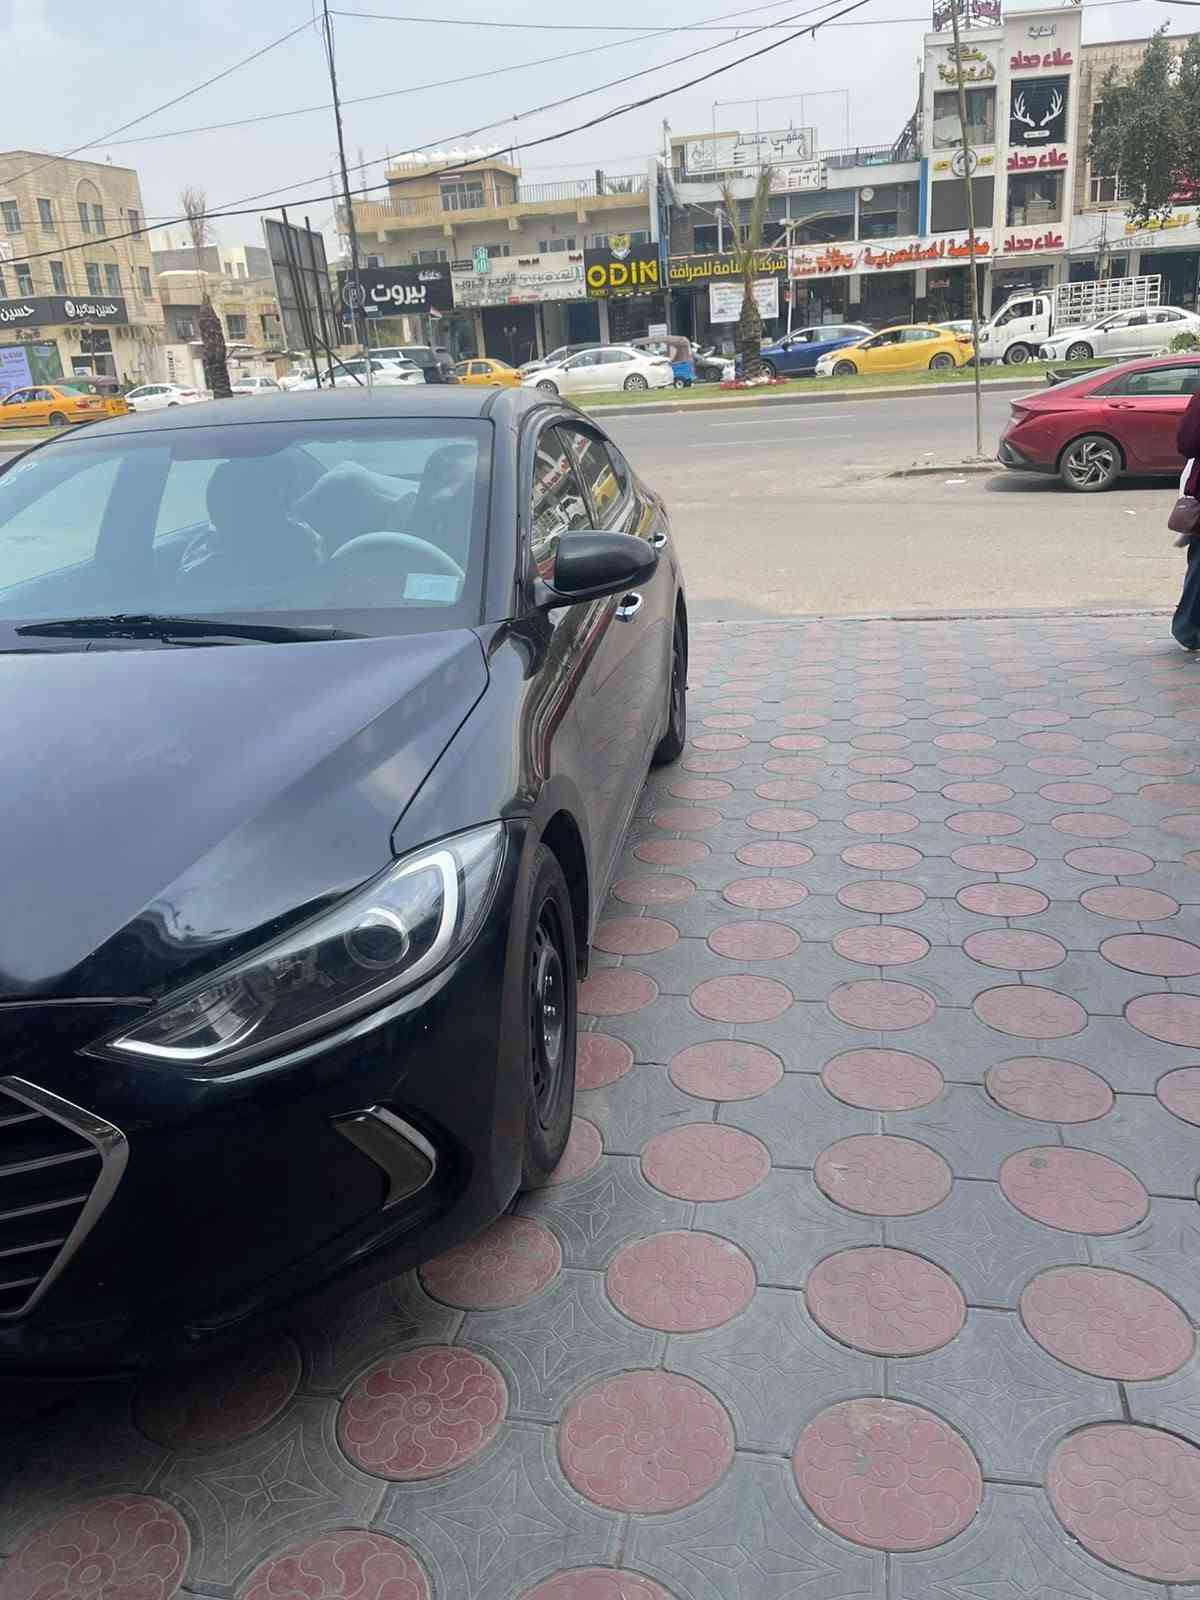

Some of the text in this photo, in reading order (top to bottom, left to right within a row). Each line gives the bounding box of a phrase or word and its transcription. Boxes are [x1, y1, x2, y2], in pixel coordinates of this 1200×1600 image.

[587, 259, 658, 288] ODIN
[371, 284, 426, 305] بيروت
[0, 305, 35, 321] حسين
